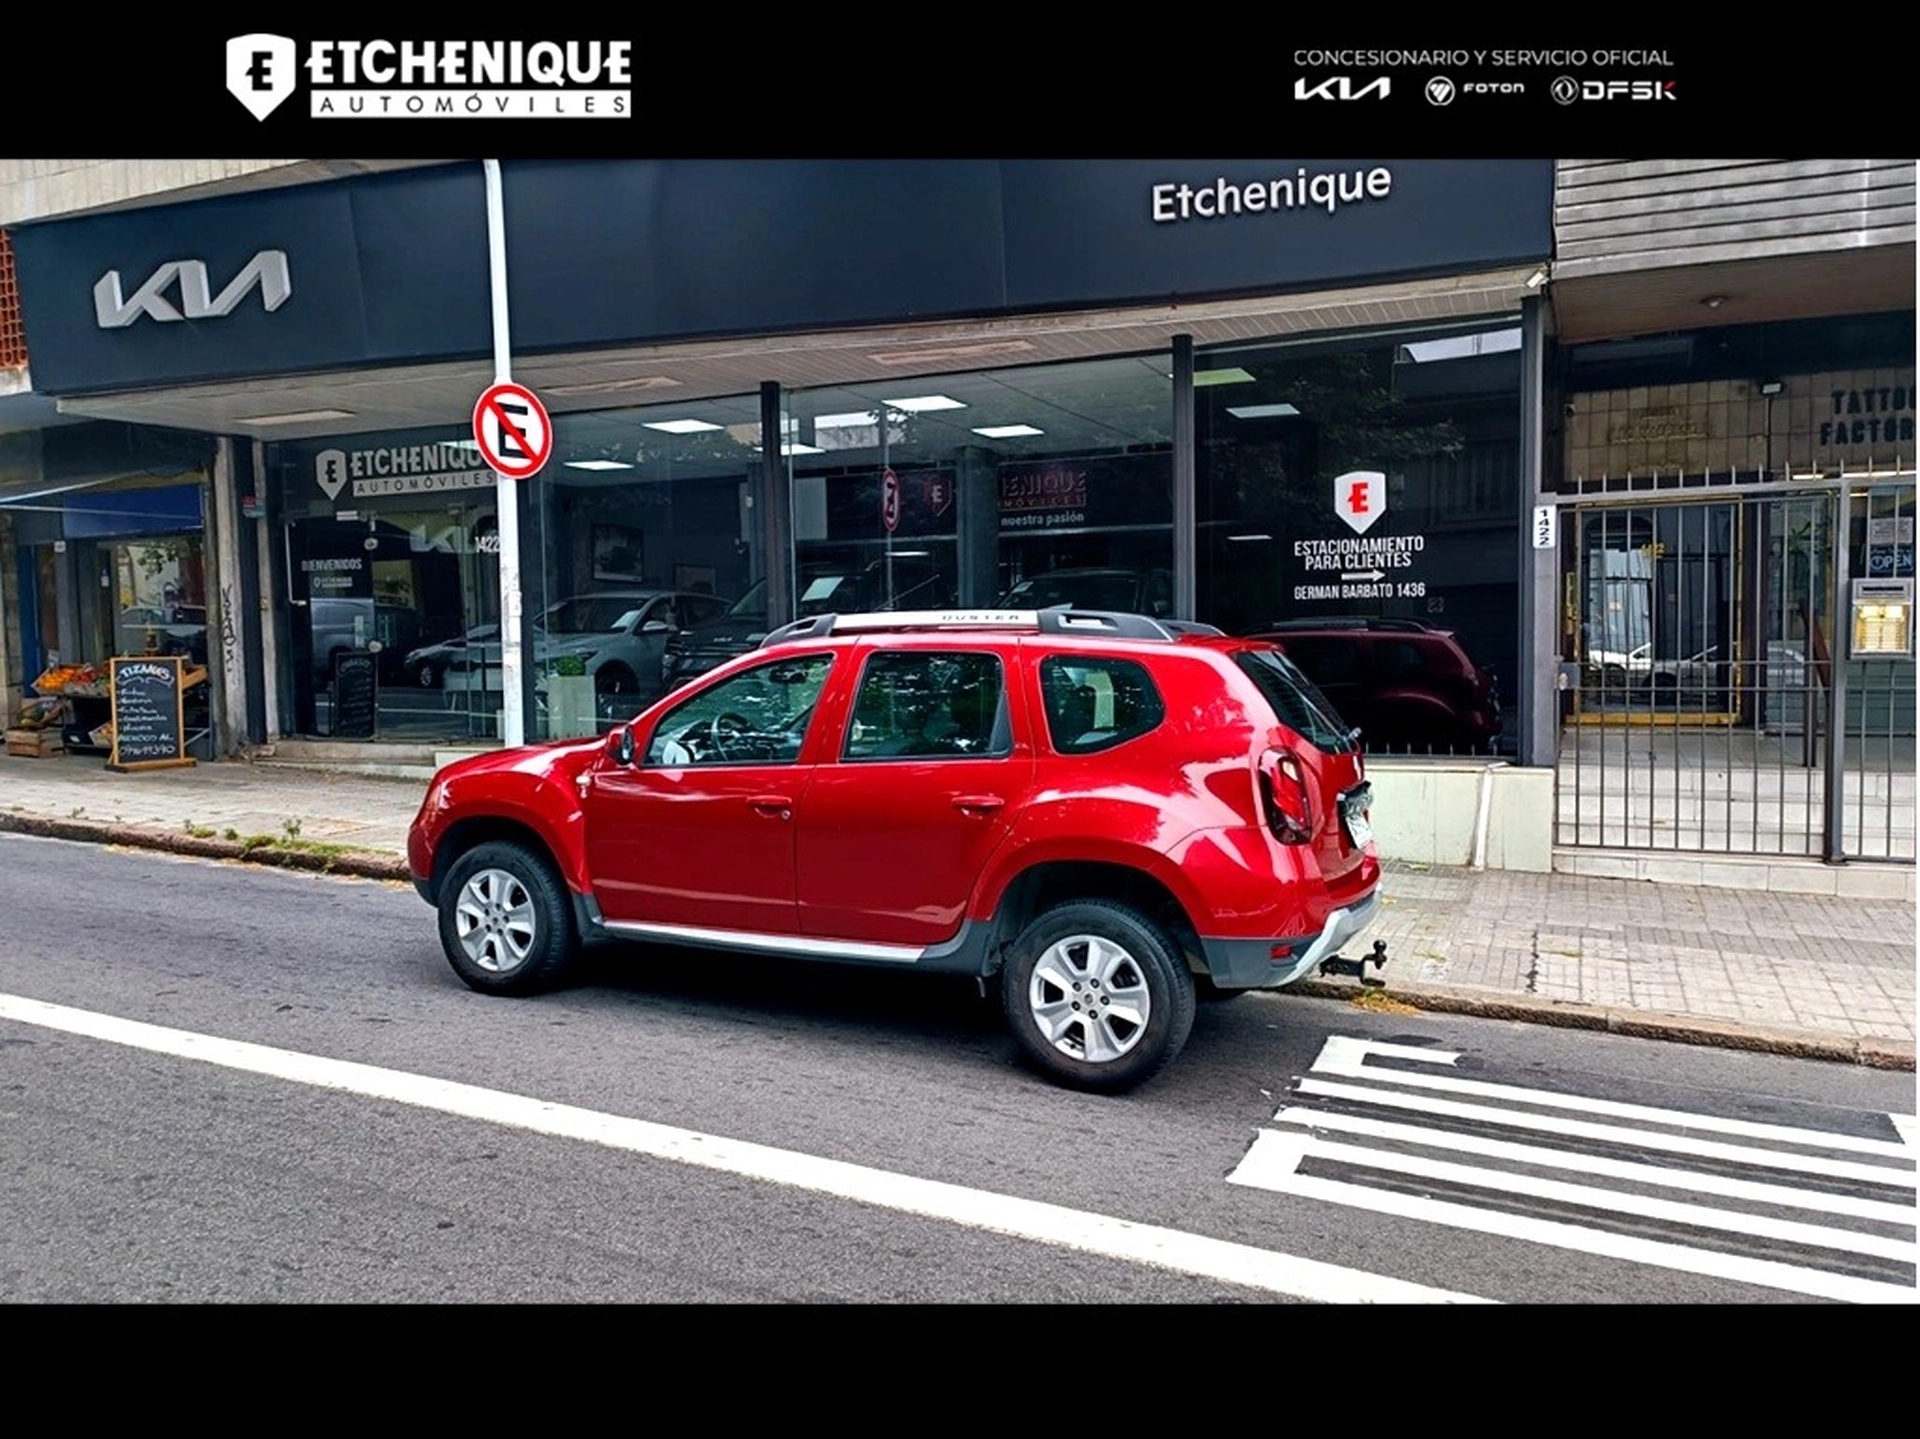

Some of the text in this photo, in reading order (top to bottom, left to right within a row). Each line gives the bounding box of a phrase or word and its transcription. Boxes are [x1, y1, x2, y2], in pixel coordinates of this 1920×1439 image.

[1152, 167, 1392, 221] Etchenique
[93, 249, 292, 329] KIA
[1820, 417, 1914, 446] FACTOR
[350, 445, 483, 477] ETCHENIQU
[356, 473, 494, 494] AUTOMÓVILES
[1001, 509, 1085, 527] nuestra pasión
[1539, 509, 1550, 546] 1422
[1294, 535, 1424, 557] ESTACIONAMIENTO
[1305, 550, 1412, 571] PARA CLIENTES
[1294, 582, 1426, 601] GERMAN BARBATO 1436
